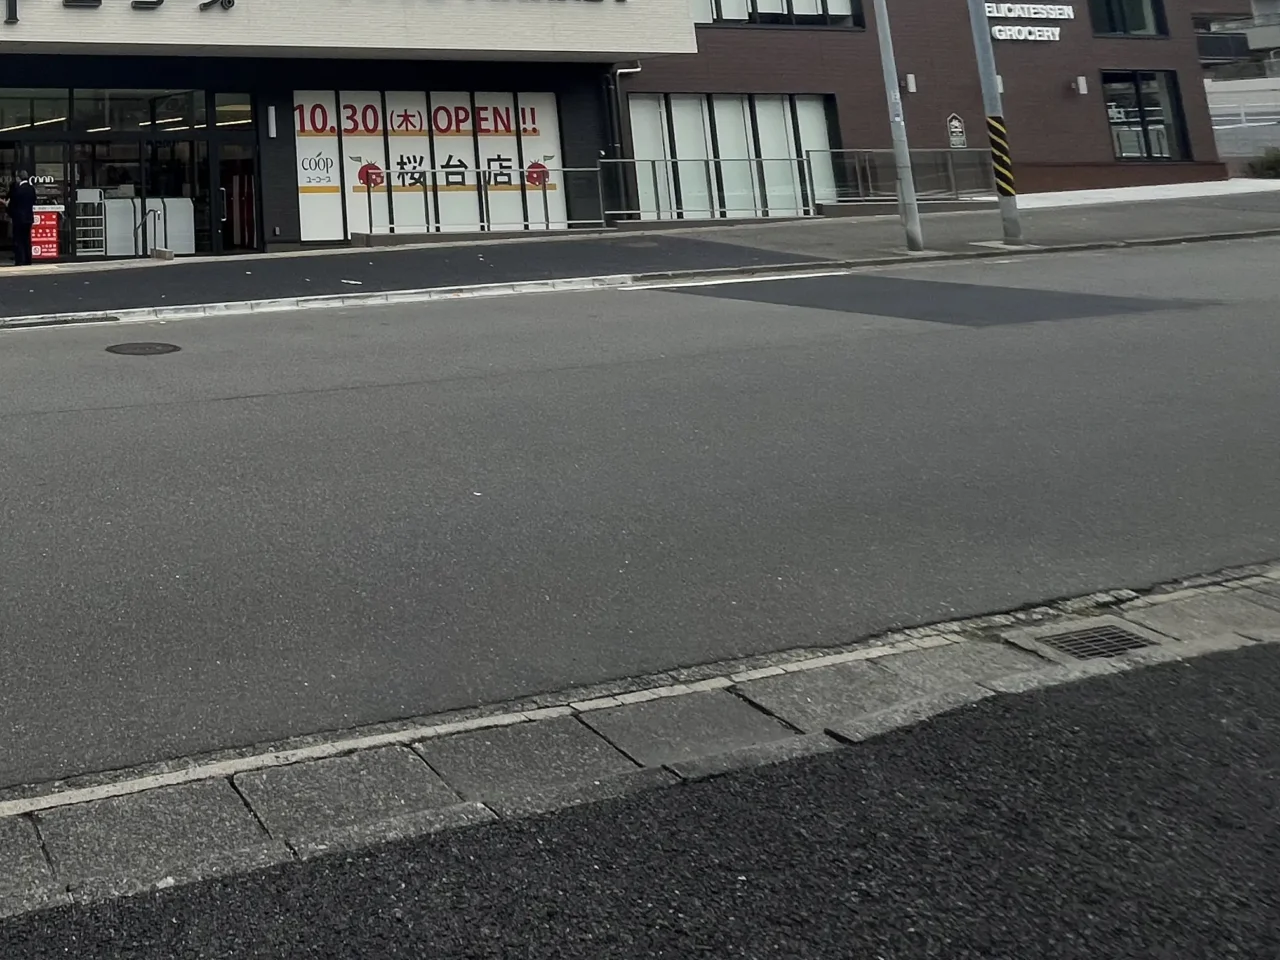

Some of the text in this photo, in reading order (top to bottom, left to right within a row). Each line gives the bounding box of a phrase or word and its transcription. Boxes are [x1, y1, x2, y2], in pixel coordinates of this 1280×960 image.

[984, 3, 1074, 19] ELICATESSEN
[992, 25, 1061, 41] GROCERY
[396, 154, 513, 187] 桜台店
